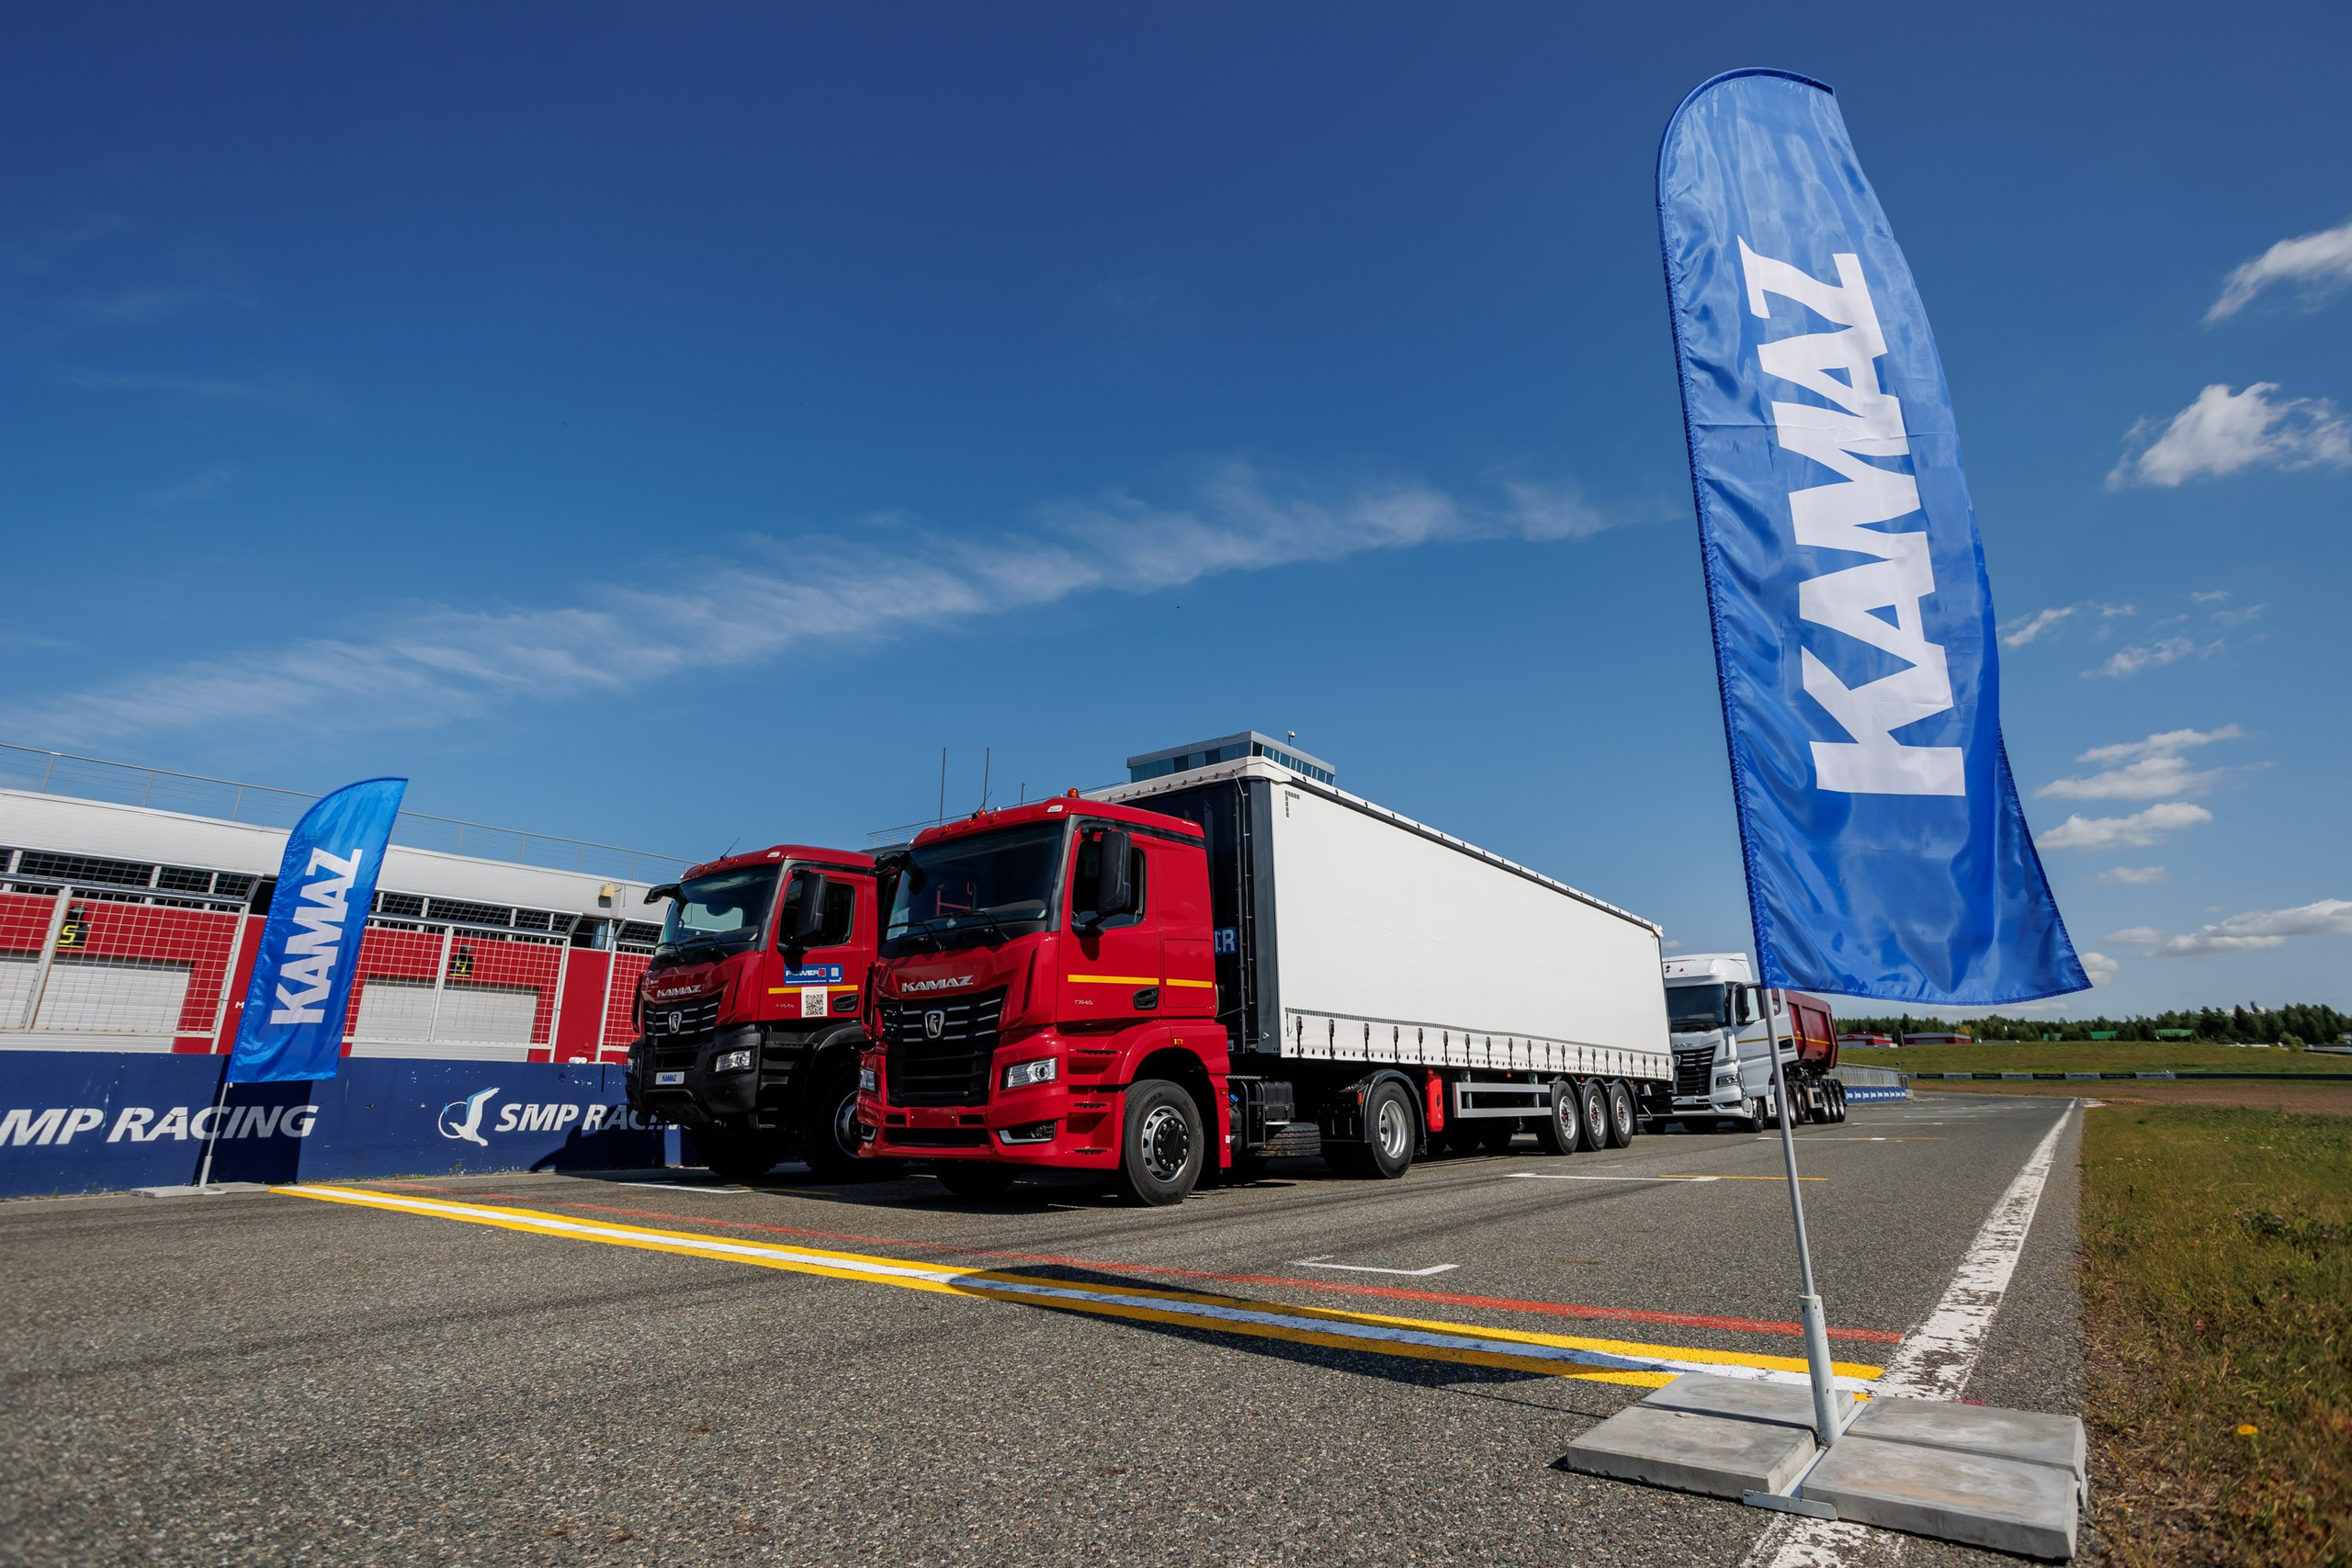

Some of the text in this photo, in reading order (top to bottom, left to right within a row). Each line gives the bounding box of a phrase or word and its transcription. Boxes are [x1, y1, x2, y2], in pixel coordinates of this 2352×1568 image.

[1737, 234, 1965, 796] KAMAZ
[270, 847, 362, 1024] KAMAZ
[656, 985, 701, 998] KAMAZ
[902, 976, 974, 992] KAMAZ
[0, 1105, 319, 1146] MP RACING
[494, 1103, 580, 1132] SMP
